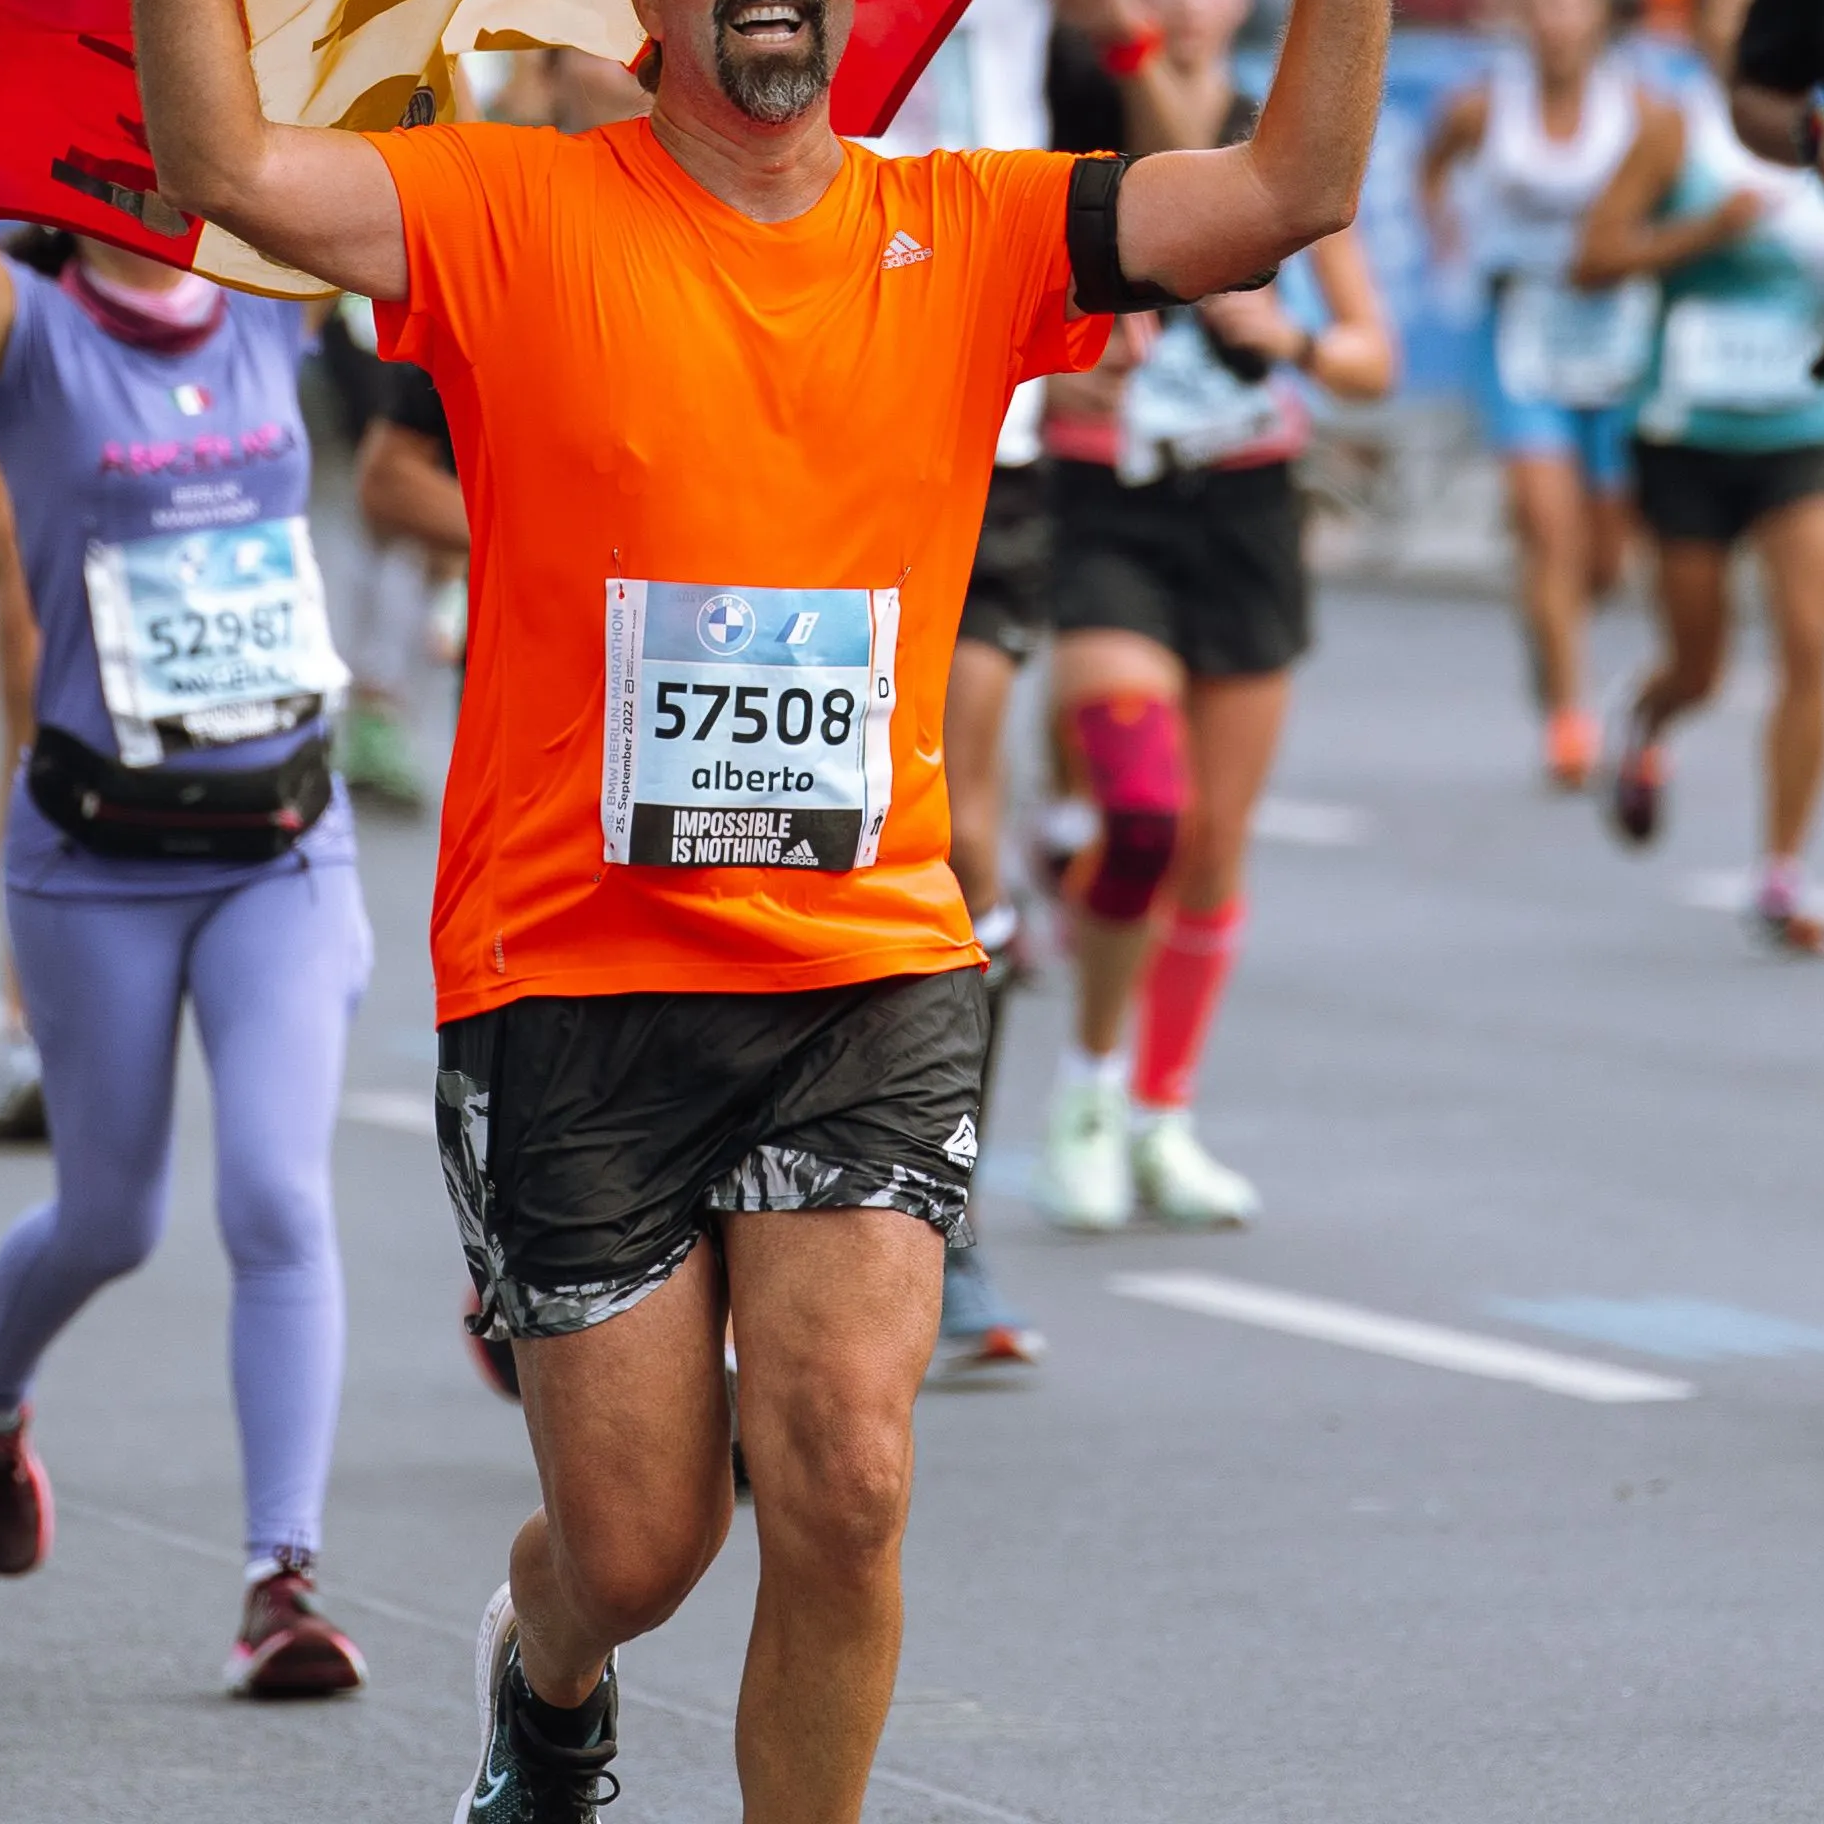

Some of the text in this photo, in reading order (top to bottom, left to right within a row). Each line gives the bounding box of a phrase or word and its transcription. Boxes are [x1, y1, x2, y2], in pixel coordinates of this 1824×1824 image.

[879, 247, 933, 270] adidas
[609, 609, 624, 763] BERLIN-MARATHON
[878, 677, 889, 698] D
[654, 681, 855, 746] 57508
[616, 700, 634, 833] 25. September 2022
[691, 760, 814, 793] alberto
[607, 768, 618, 805] BMW
[673, 810, 792, 839] IMPOSSIBLE
[671, 837, 782, 865] IS NOTHING
[781, 855, 819, 866] adidas
